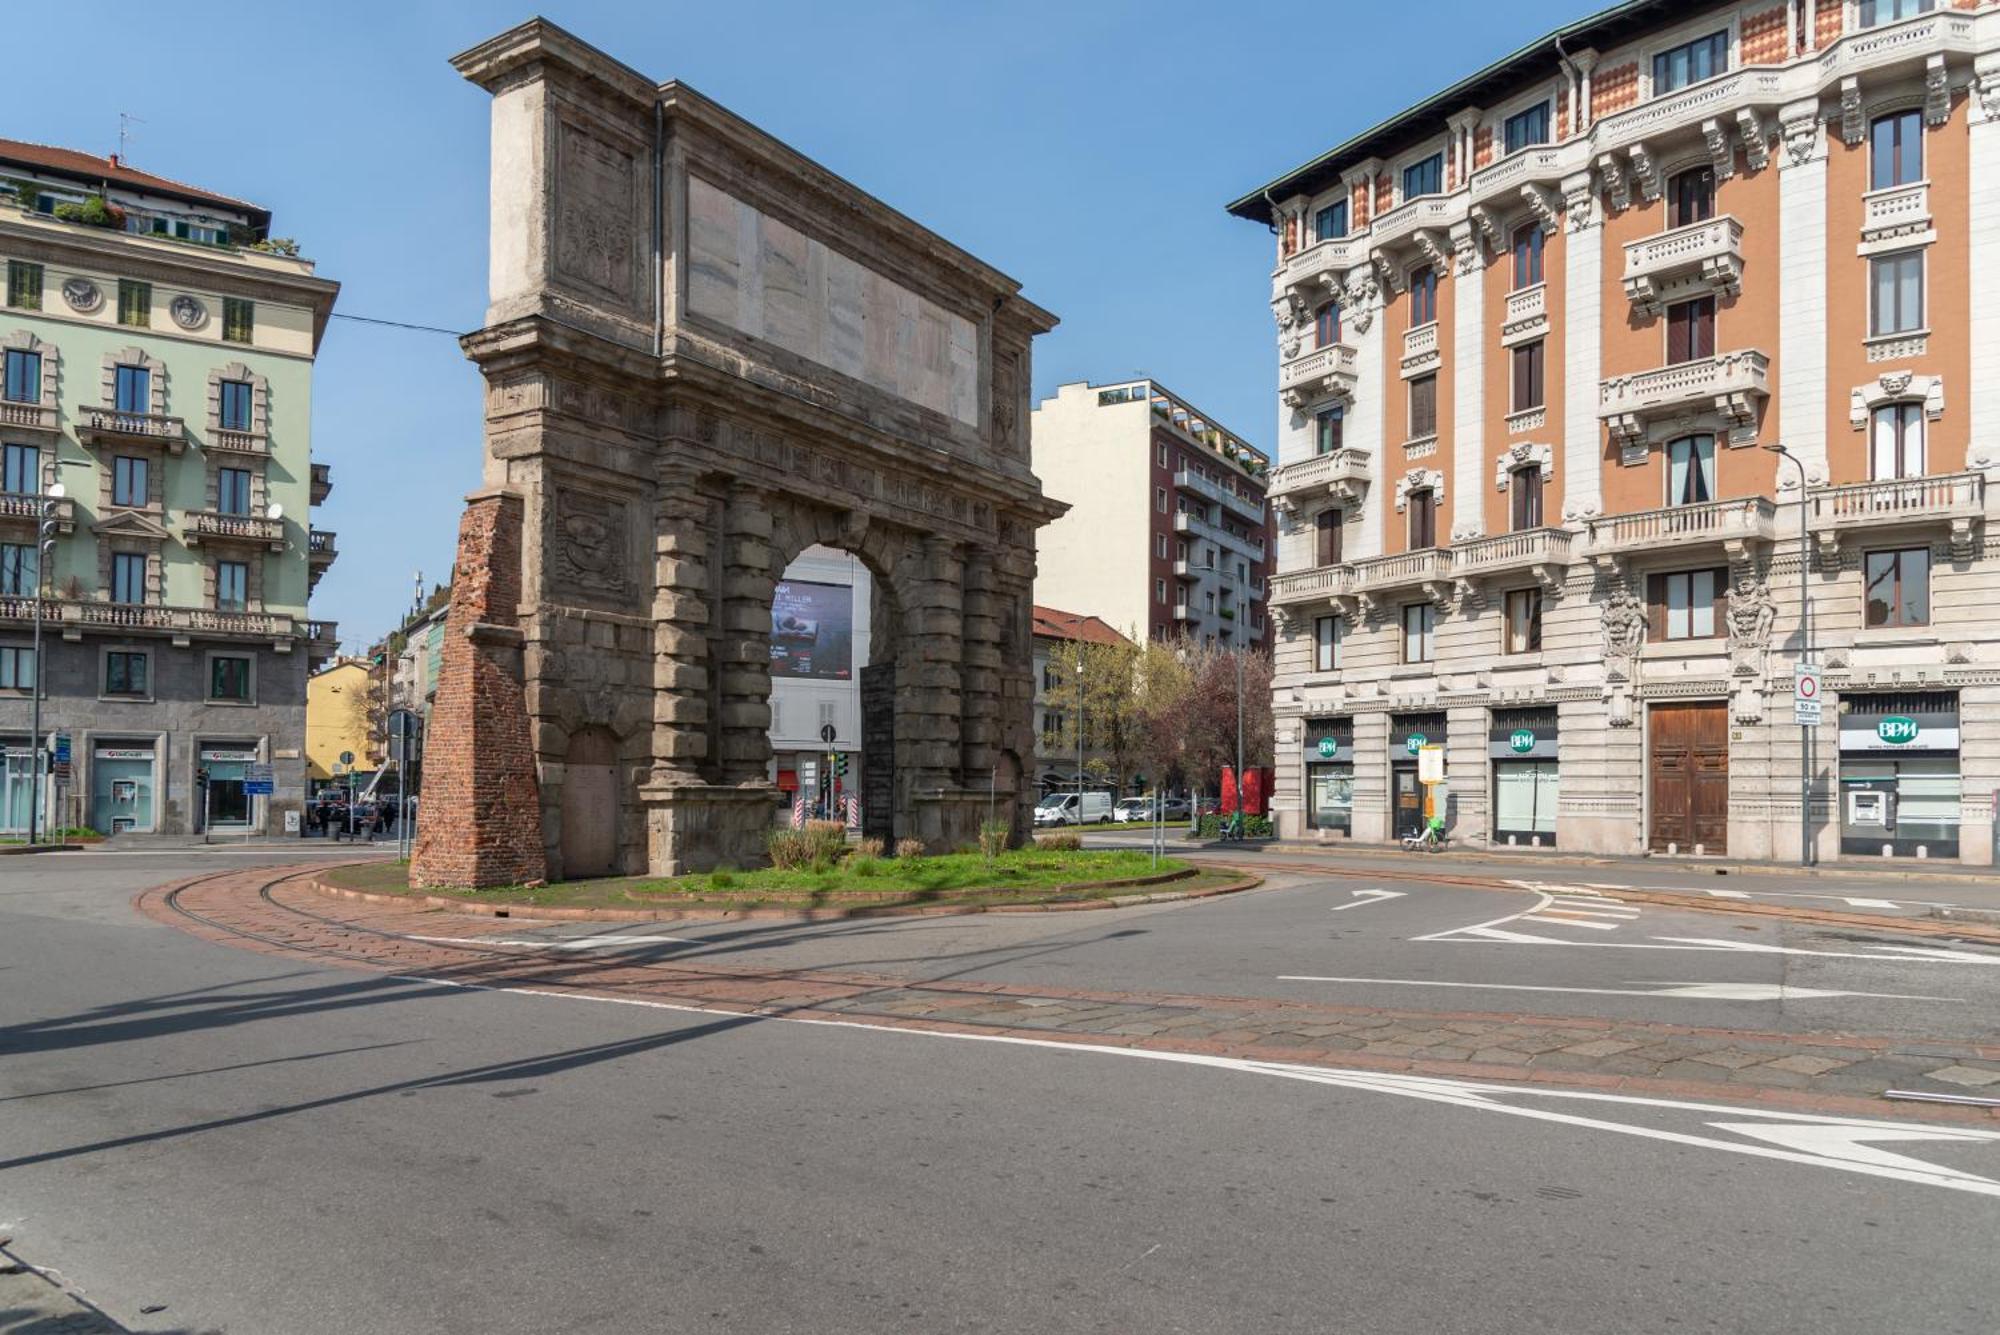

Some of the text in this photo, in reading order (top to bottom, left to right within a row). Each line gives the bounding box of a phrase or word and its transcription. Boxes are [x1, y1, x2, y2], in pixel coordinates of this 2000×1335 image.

[1879, 722, 1917, 737] BPM
[1318, 742, 1336, 753] BPM
[1511, 734, 1534, 748] BPM
